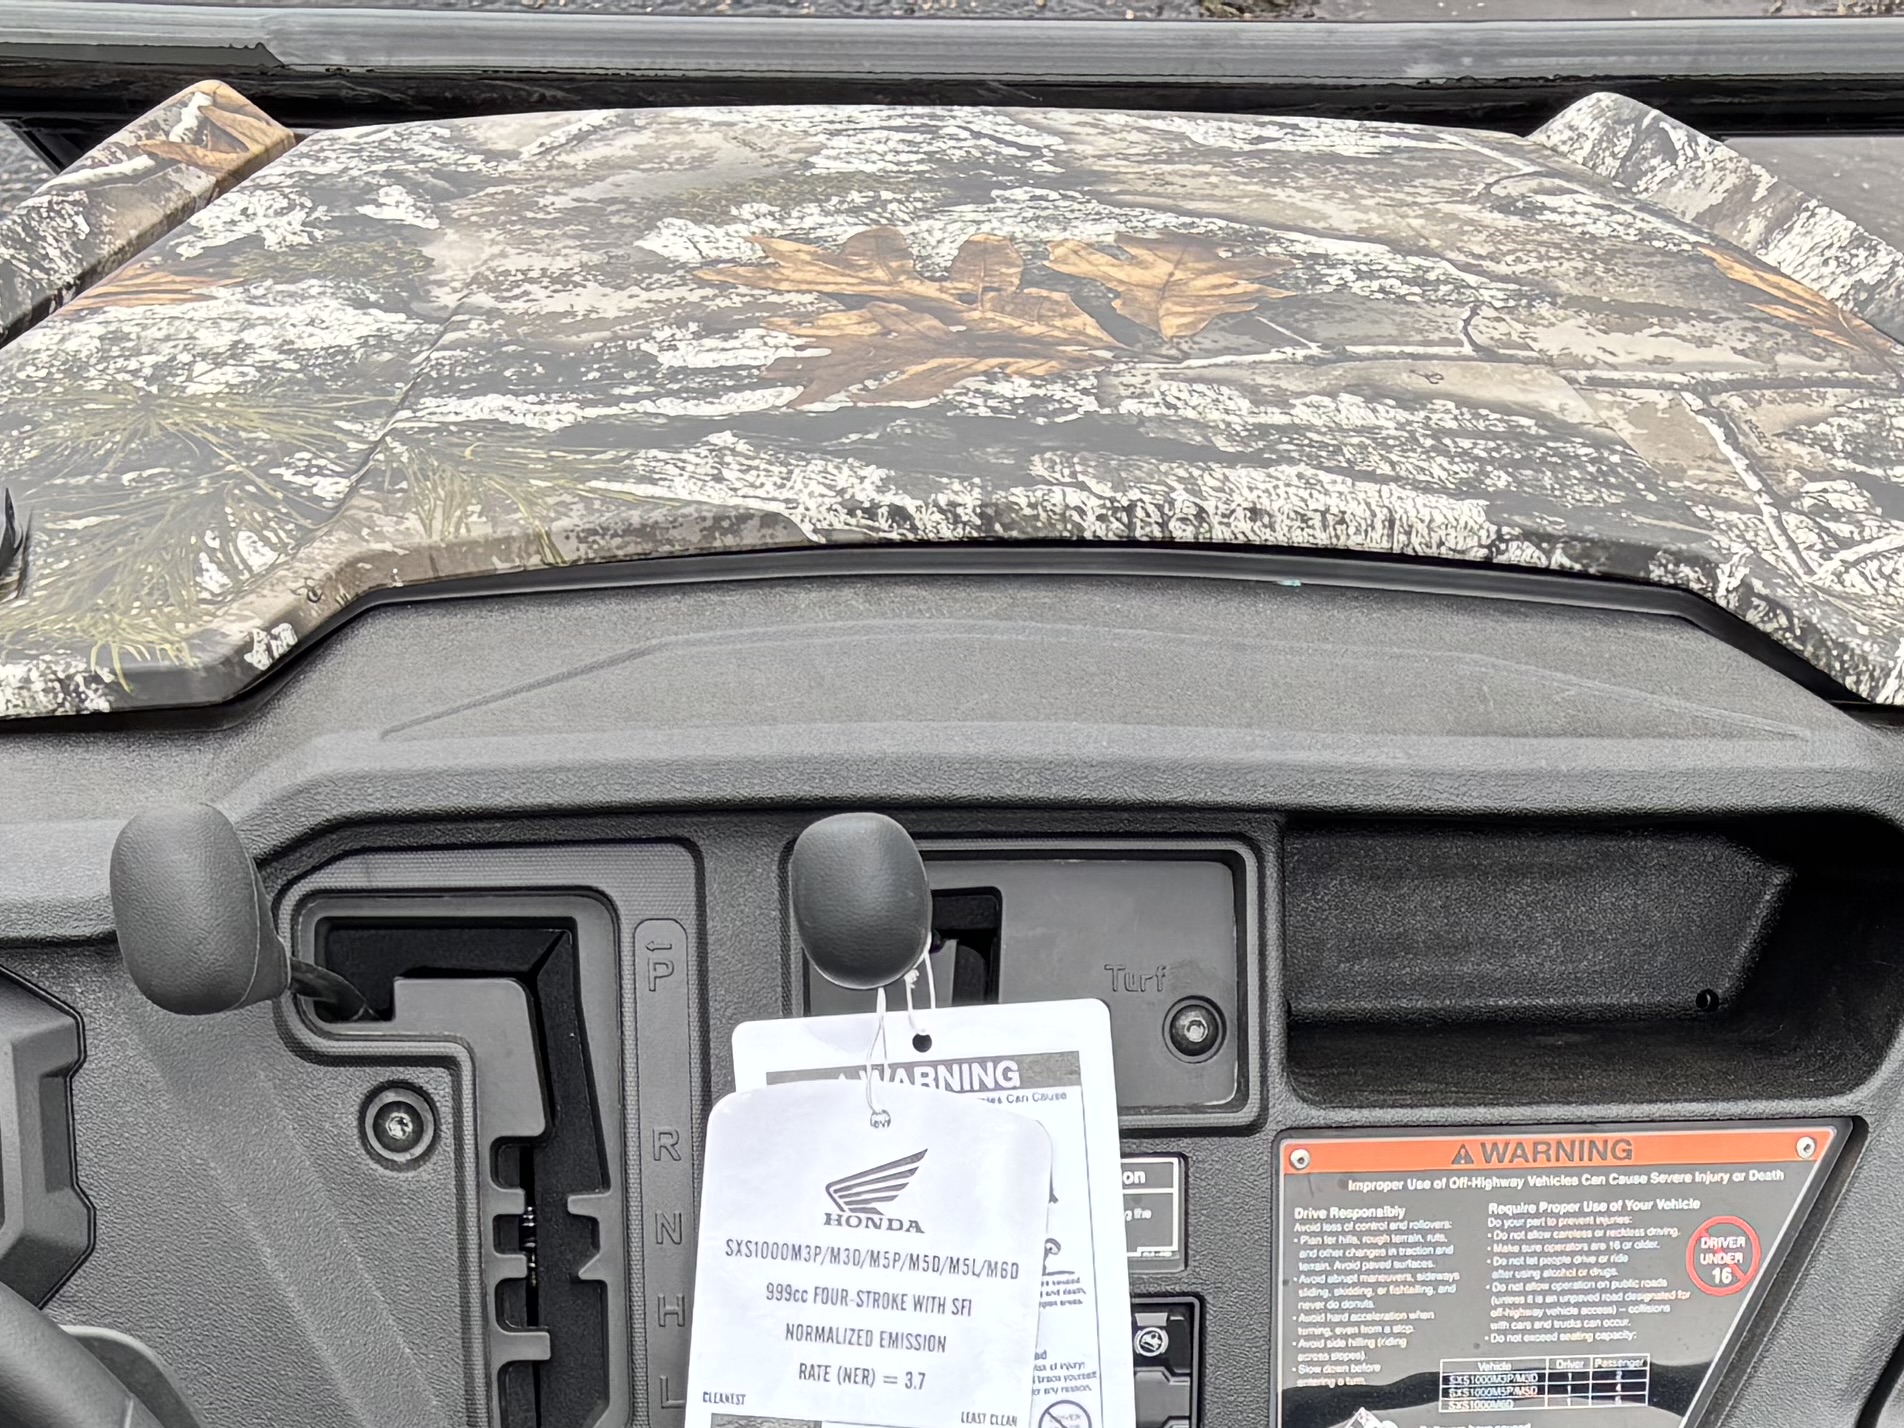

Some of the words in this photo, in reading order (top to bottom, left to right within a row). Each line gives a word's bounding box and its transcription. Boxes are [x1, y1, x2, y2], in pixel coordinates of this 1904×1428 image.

[647, 961, 674, 992] P
[1105, 964, 1168, 991] Turf
[653, 1129, 682, 1161] R
[1480, 1139, 1634, 1164] WARNING
[1348, 1178, 1404, 1193] Improper
[1407, 1178, 1431, 1190] Use
[1433, 1177, 1446, 1189] of
[1449, 1174, 1524, 1191] Off-Highway
[1527, 1174, 1578, 1186] Vehicles
[1581, 1173, 1605, 1185] Can
[1608, 1172, 1647, 1184] Cause
[1650, 1171, 1692, 1183] Severe
[1695, 1170, 1730, 1185] Injury
[1732, 1172, 1746, 1181] or
[1748, 1168, 1784, 1181] Death
[1294, 1207, 1327, 1219] Drive
[1488, 1201, 1536, 1216] Require
[1538, 1200, 1580, 1215] Proper
[1583, 1200, 1607, 1212] Use
[1609, 1199, 1622, 1211] of
[1625, 1198, 1653, 1210] Your
[1656, 1197, 1700, 1210] Vehicle
[655, 1211, 682, 1246] N
[824, 1211, 925, 1234] HONDA
[1700, 1236, 1745, 1250] DRIVER
[1699, 1252, 1743, 1265] UNDER
[1711, 1268, 1733, 1284] 16
[657, 1295, 685, 1327] H
[765, 1282, 808, 1303] 999cc
[813, 1286, 907, 1311] FOUR-STROKE
[911, 1294, 946, 1314] WITH
[951, 1297, 971, 1316] SFI
[785, 1323, 873, 1347] NORMALIZED
[879, 1330, 946, 1352] EMISSION
[799, 1362, 831, 1384] RATE
[837, 1365, 876, 1388] (NER)
[904, 1371, 925, 1390] 3.7
[660, 1376, 685, 1409] L
[960, 1411, 986, 1425] LEAST
[989, 1413, 1017, 1427] CLEAN
